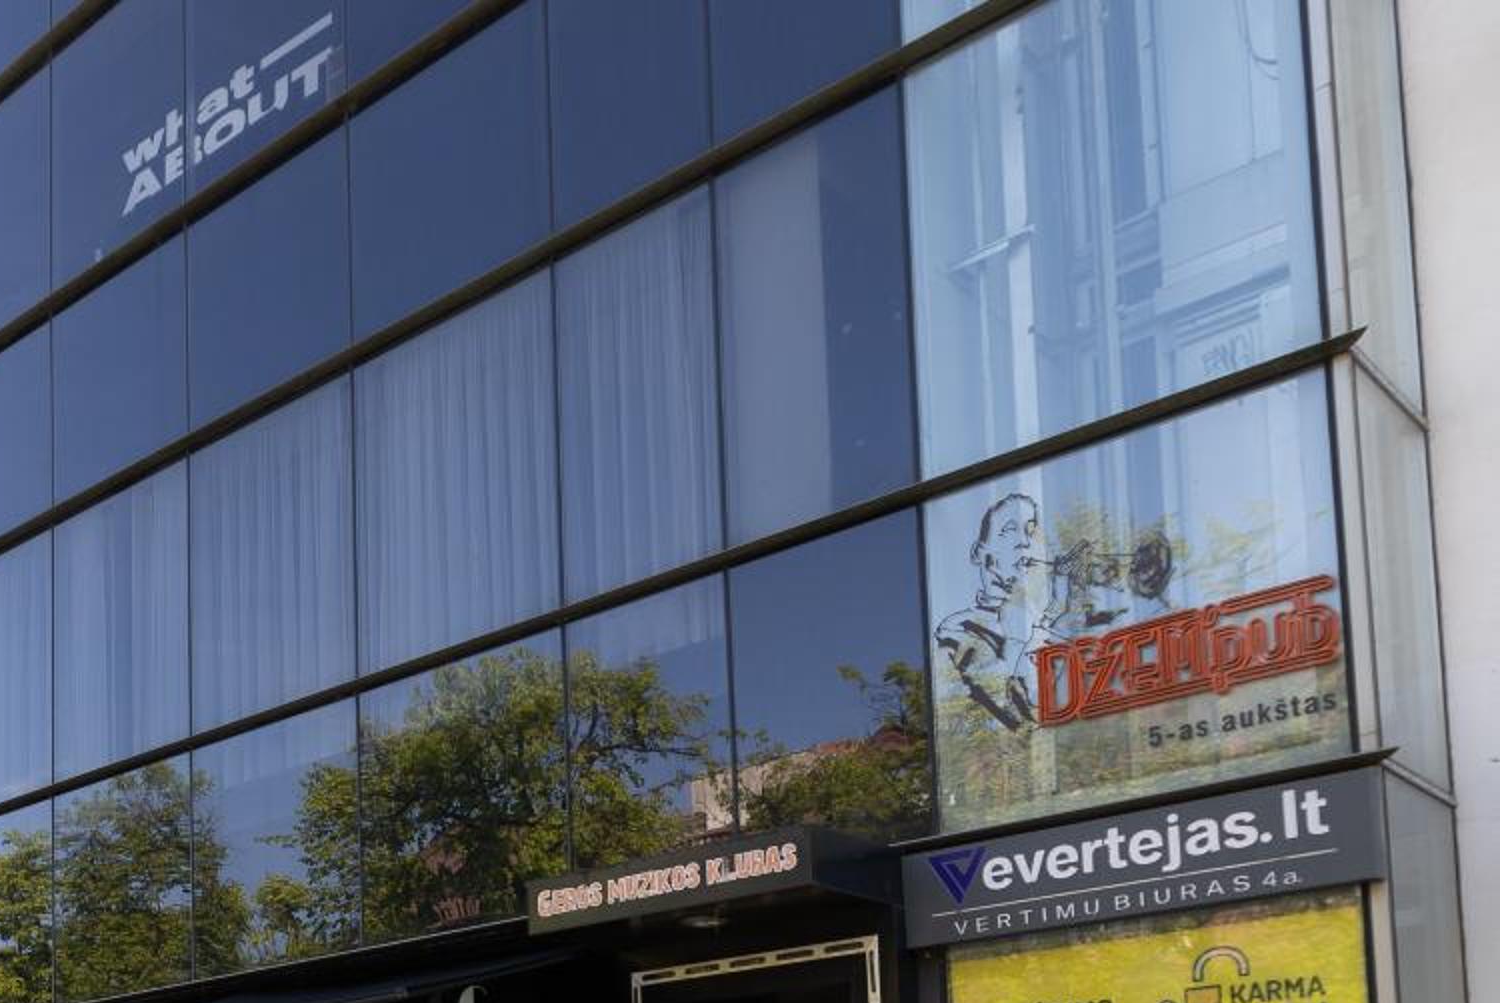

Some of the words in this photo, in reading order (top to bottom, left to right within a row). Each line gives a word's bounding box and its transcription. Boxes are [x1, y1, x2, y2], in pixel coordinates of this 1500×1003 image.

[1148, 718, 1209, 748] 5-as
[1221, 691, 1337, 732] aukštas
[537, 882, 603, 918] GEROS
[607, 862, 701, 905] MUZIKOS
[705, 842, 798, 885] KLUBAS
[1113, 875, 1251, 912] BIURAS
[1261, 869, 1300, 888] 4a
